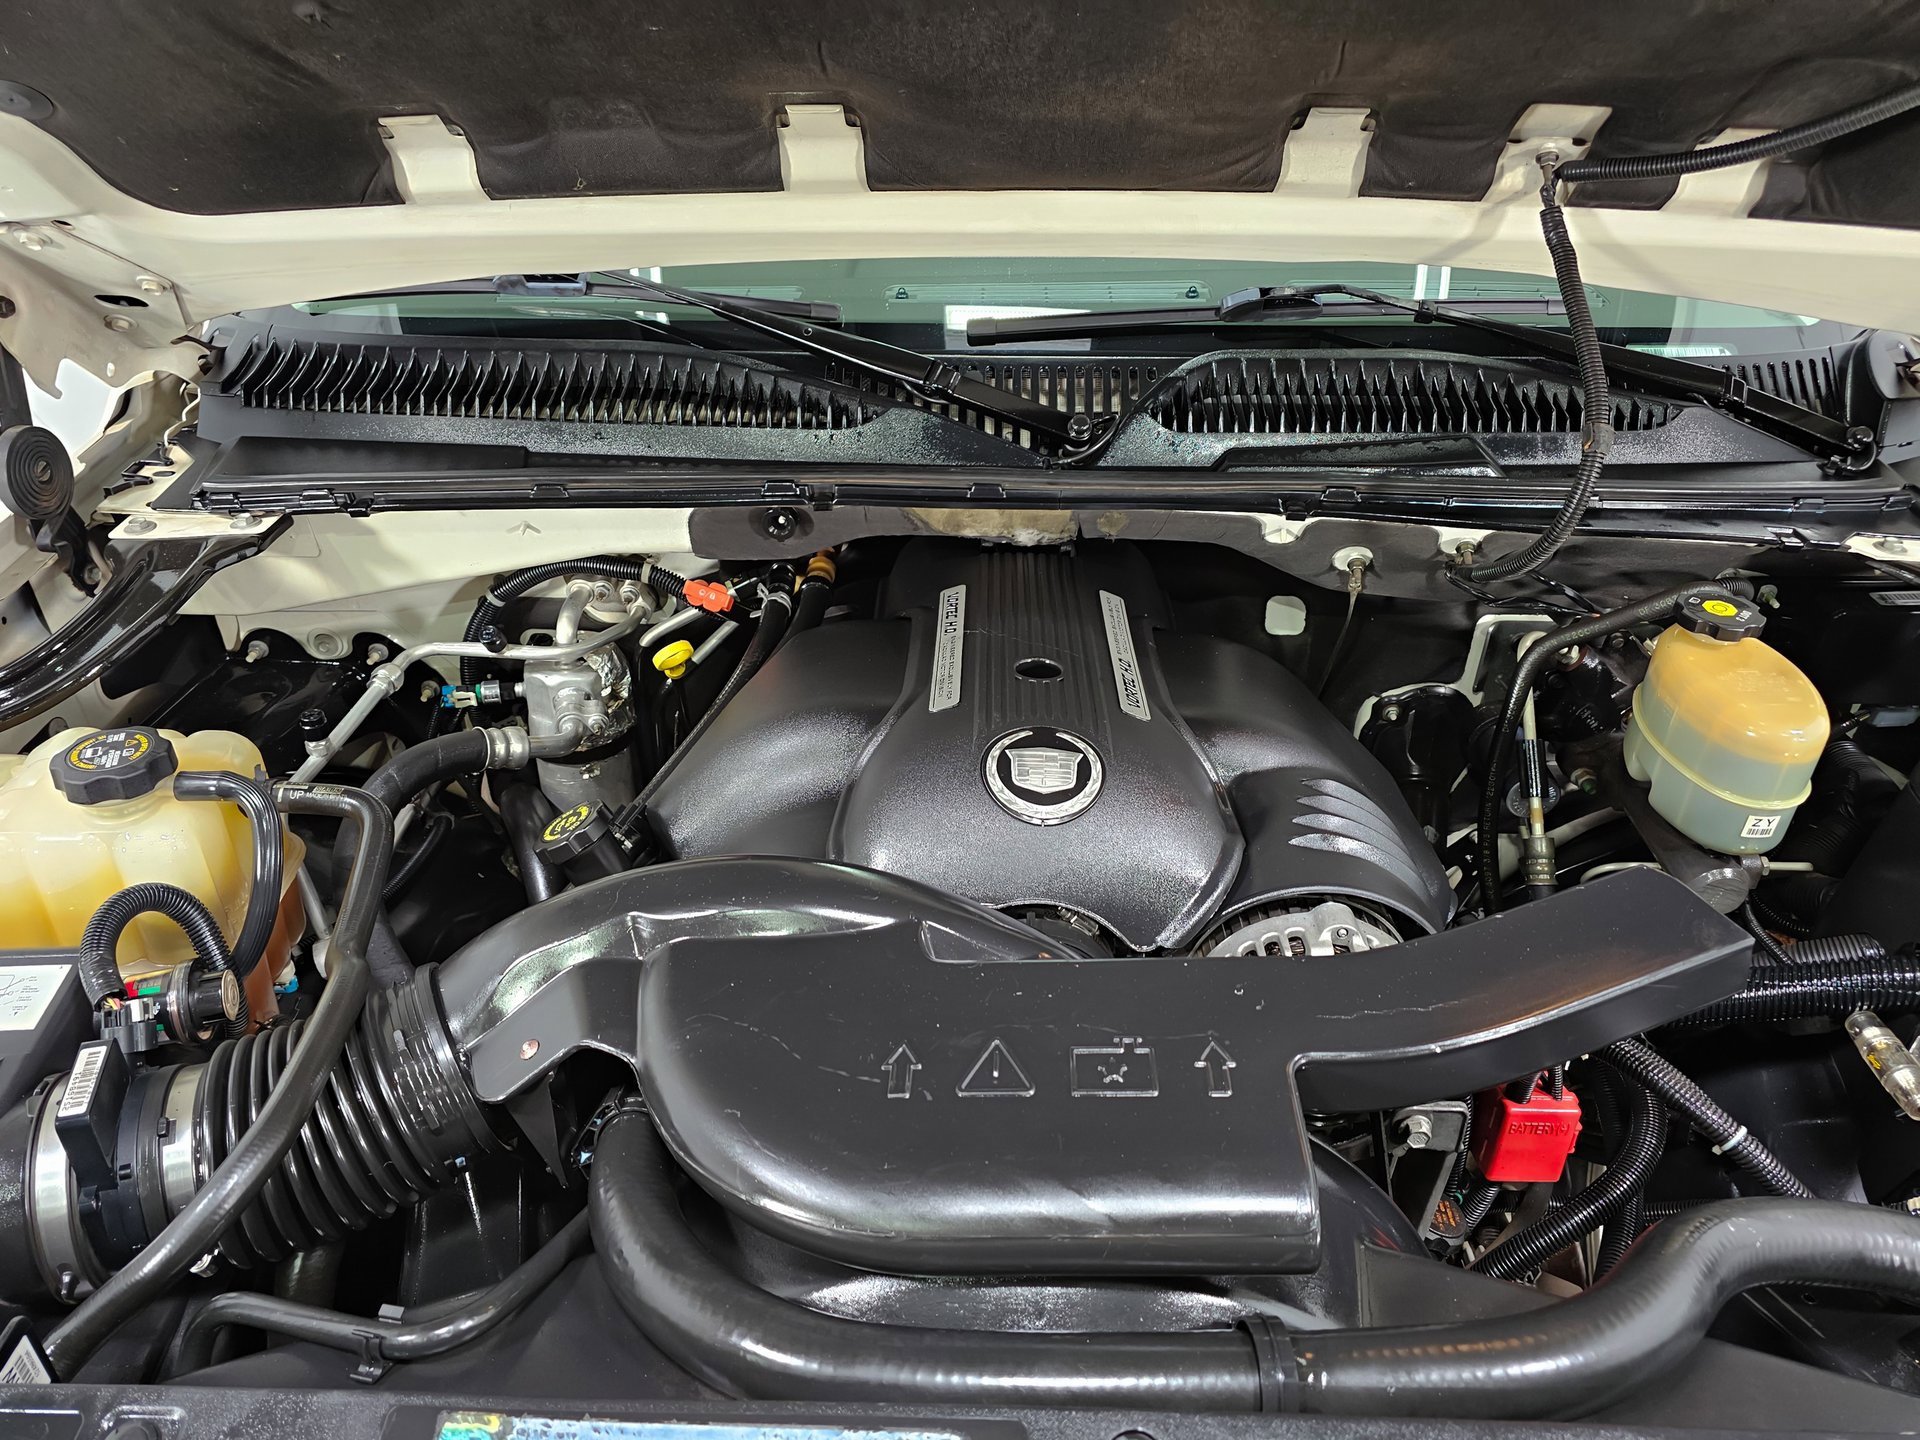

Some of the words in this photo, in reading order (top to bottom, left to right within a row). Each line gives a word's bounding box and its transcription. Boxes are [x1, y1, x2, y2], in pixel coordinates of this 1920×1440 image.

[945, 591, 960, 620] VORTEC
[1121, 672, 1141, 709] VORTEC
[289, 789, 304, 800] UP
